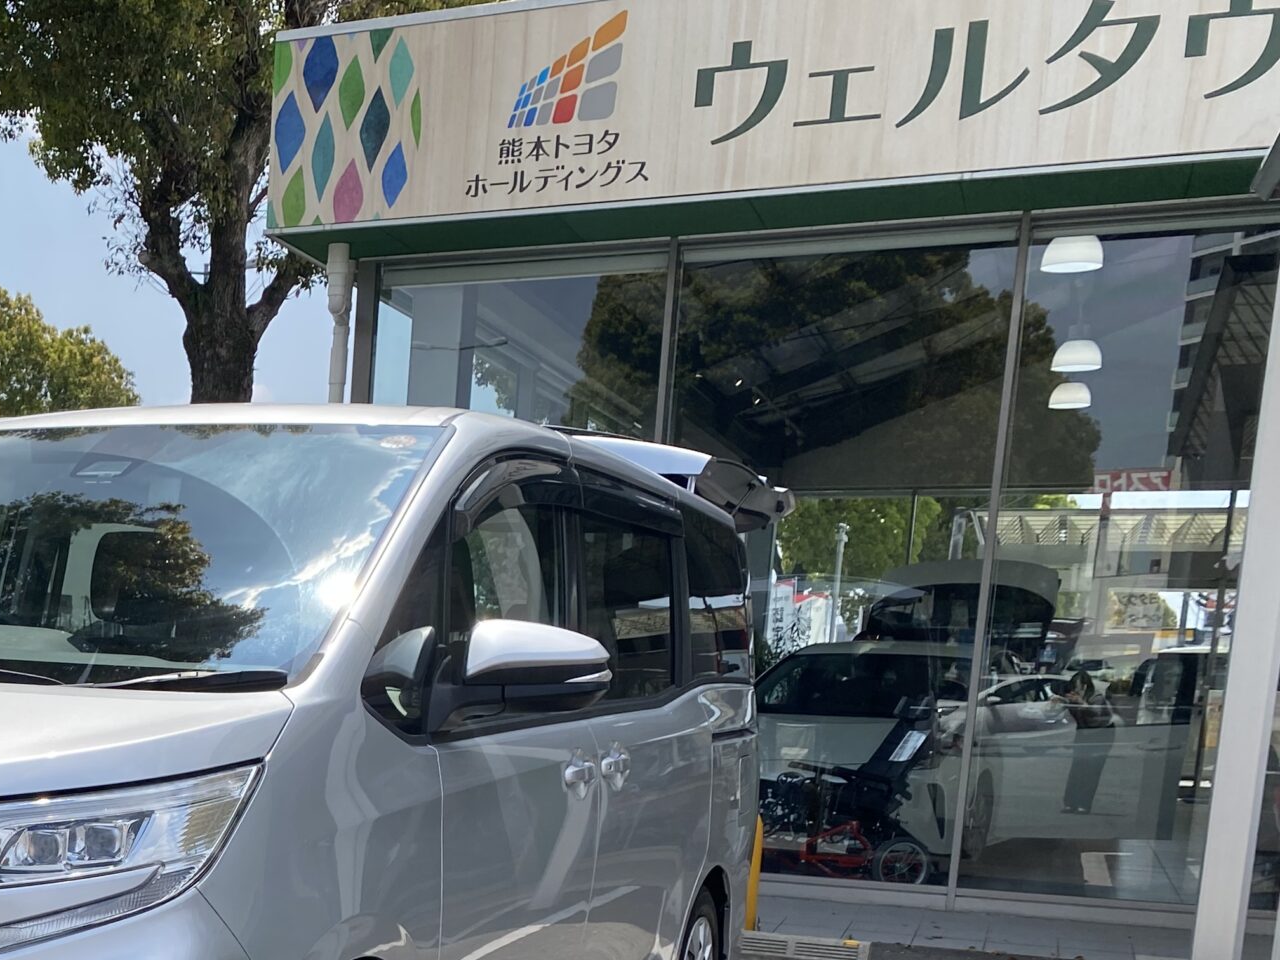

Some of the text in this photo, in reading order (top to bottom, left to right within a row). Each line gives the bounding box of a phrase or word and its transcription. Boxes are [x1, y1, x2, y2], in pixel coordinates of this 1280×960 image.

[498, 129, 620, 165] 熊本トヨタ
[465, 159, 649, 198] ホールディングス
